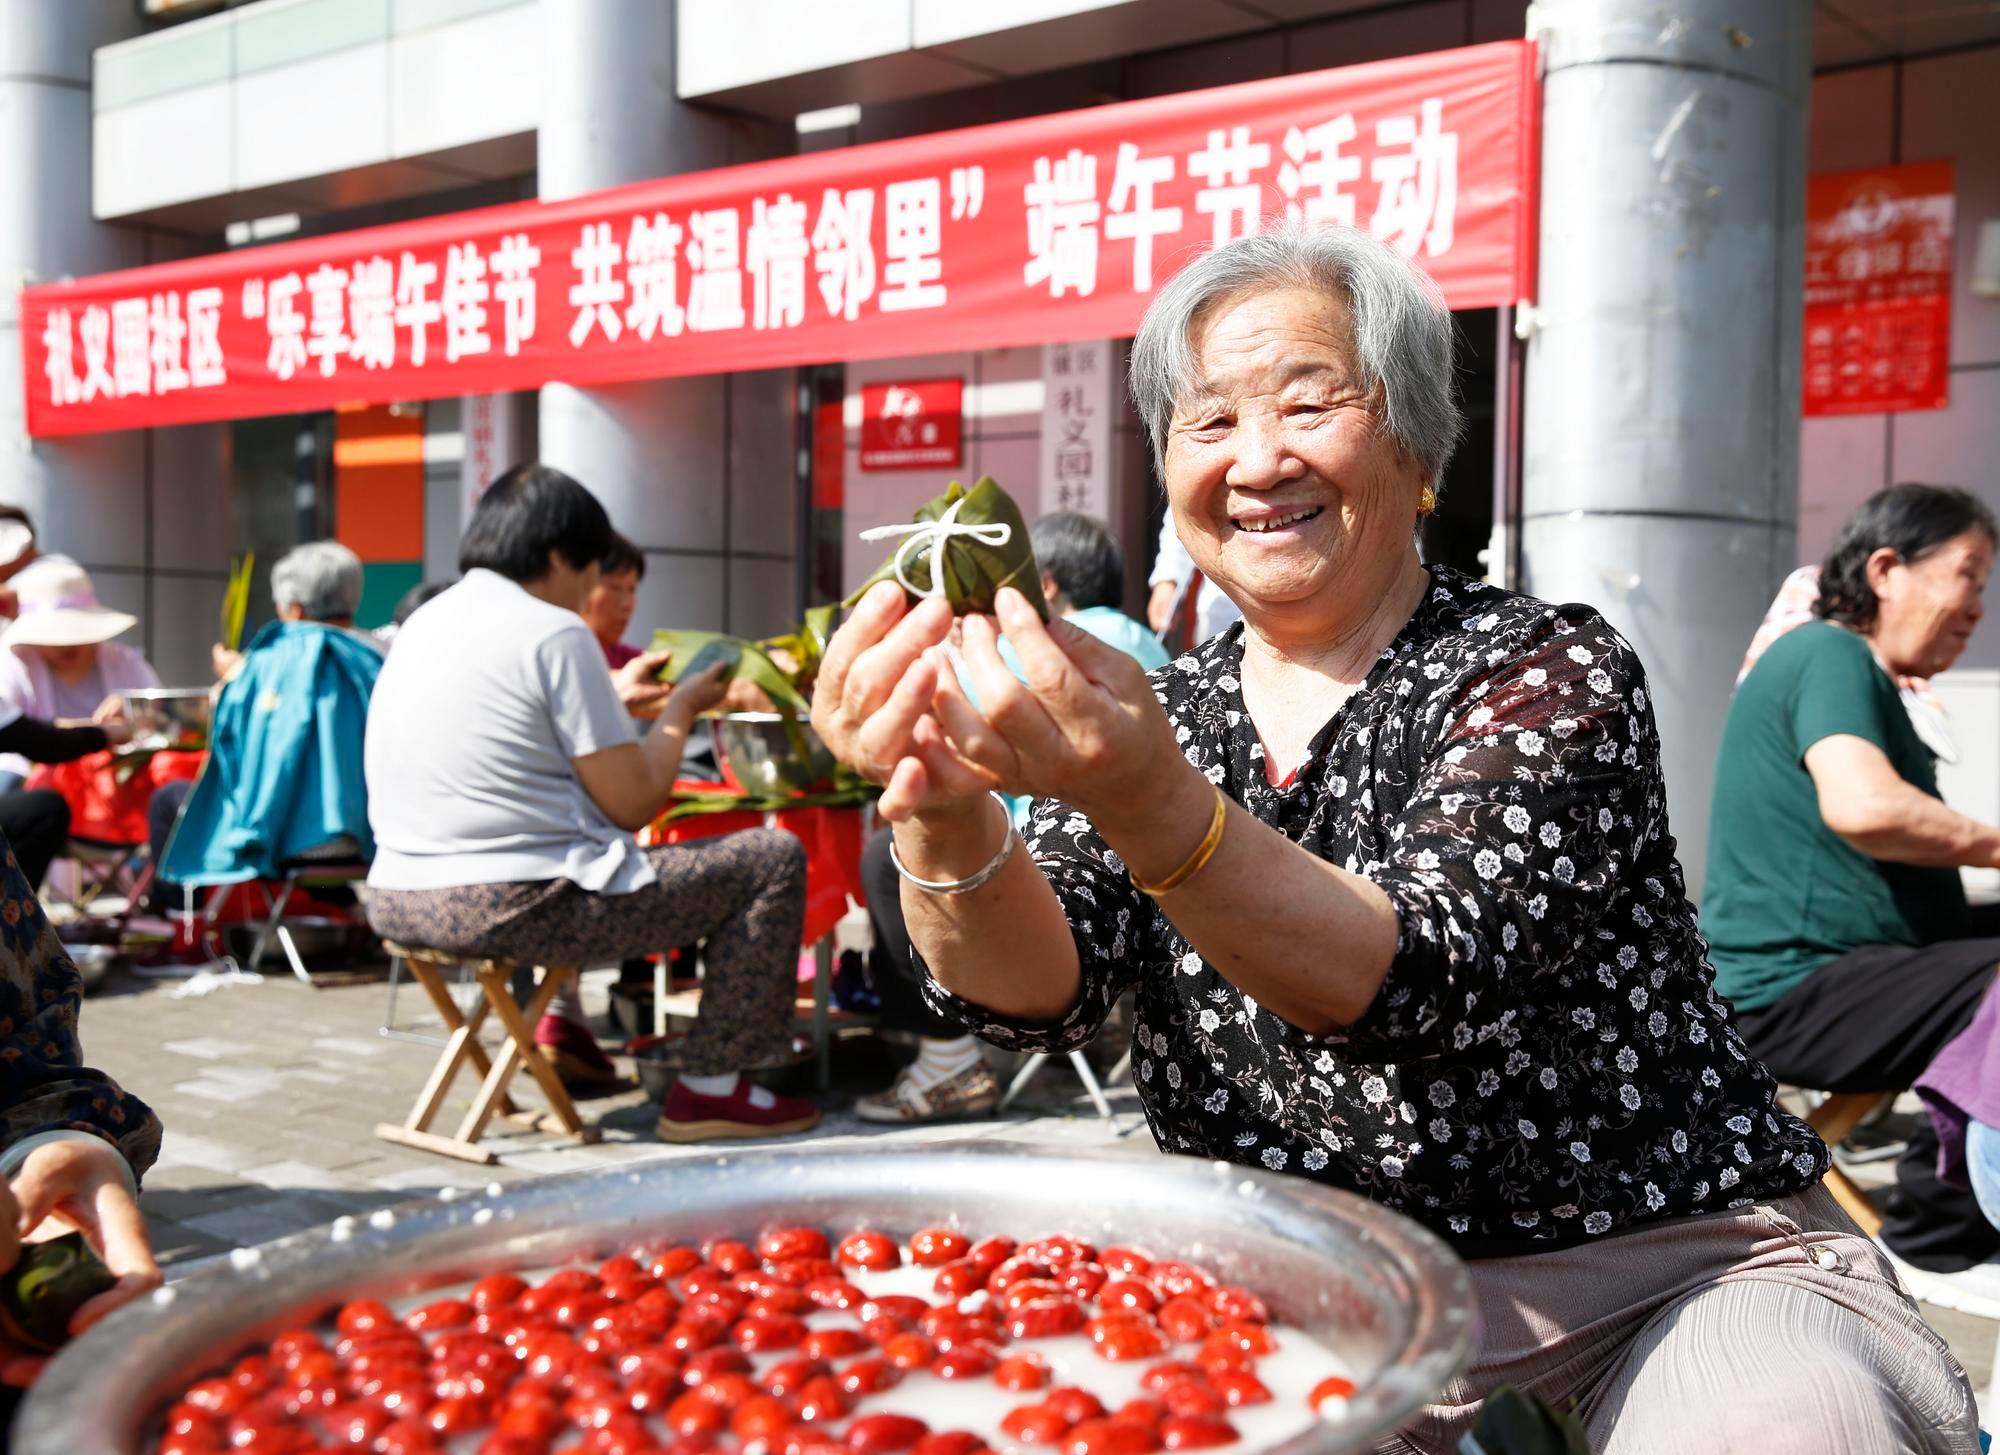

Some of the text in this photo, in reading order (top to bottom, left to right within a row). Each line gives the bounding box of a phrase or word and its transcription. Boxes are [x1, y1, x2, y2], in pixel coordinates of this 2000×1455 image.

[1023, 98, 1459, 297] 端午节活动
